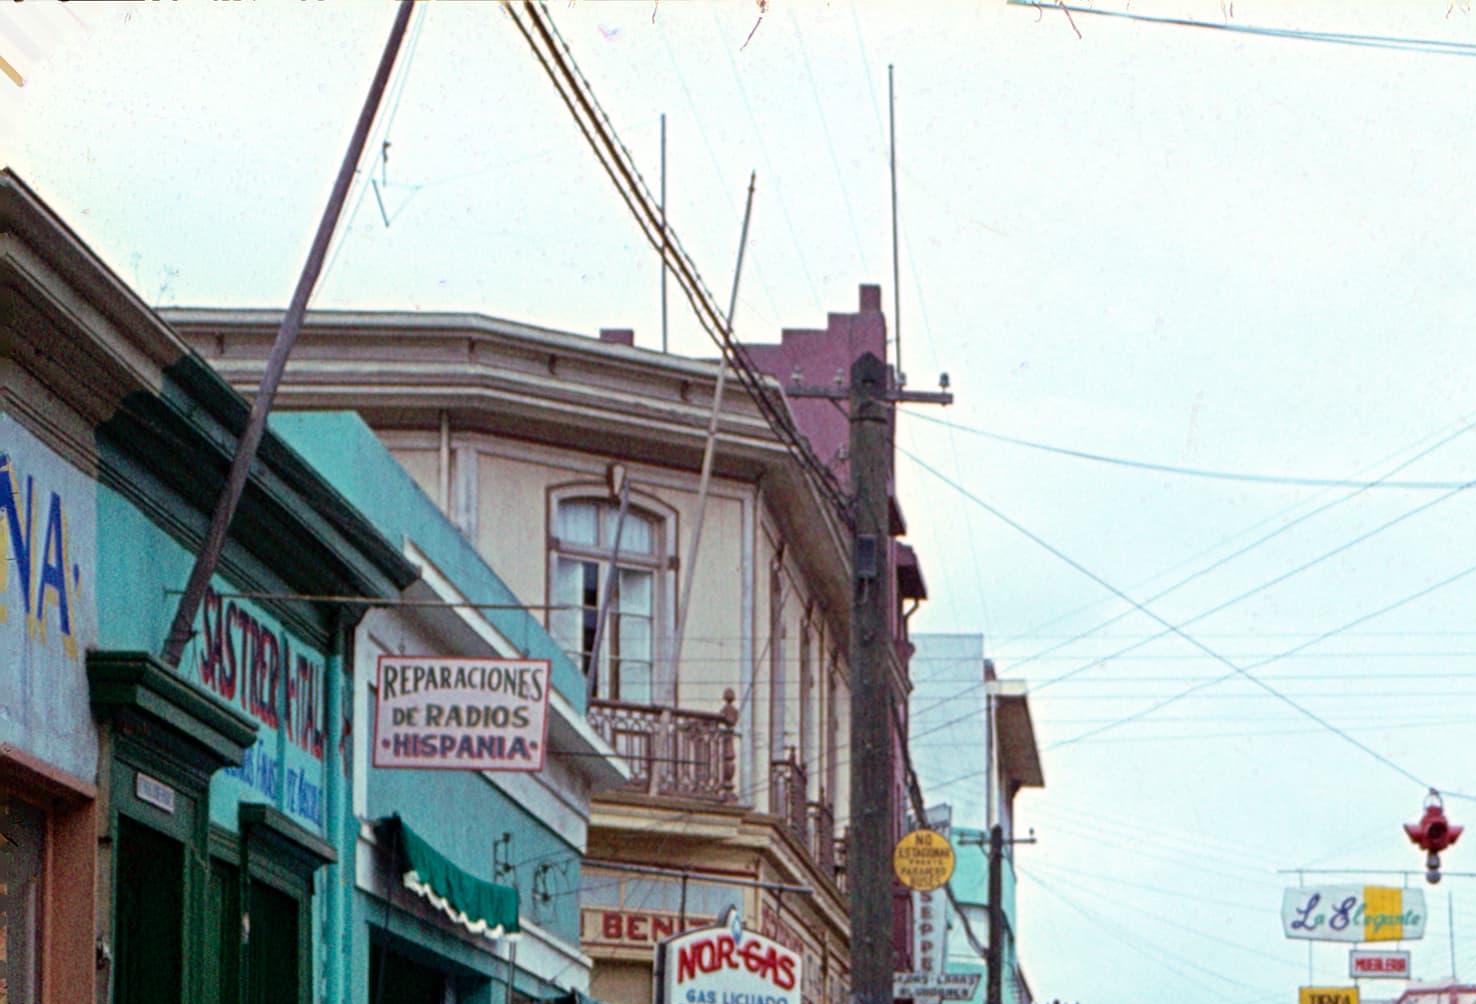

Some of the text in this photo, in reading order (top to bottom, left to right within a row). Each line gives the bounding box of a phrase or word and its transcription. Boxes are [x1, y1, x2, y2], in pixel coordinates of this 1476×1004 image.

[383, 664, 544, 703] REPARACIONES
[392, 704, 530, 728] DE RADIOS
[914, 834, 933, 846] NO
[1291, 892, 1421, 935] La Elegante
[685, 988, 717, 1004] GAS
